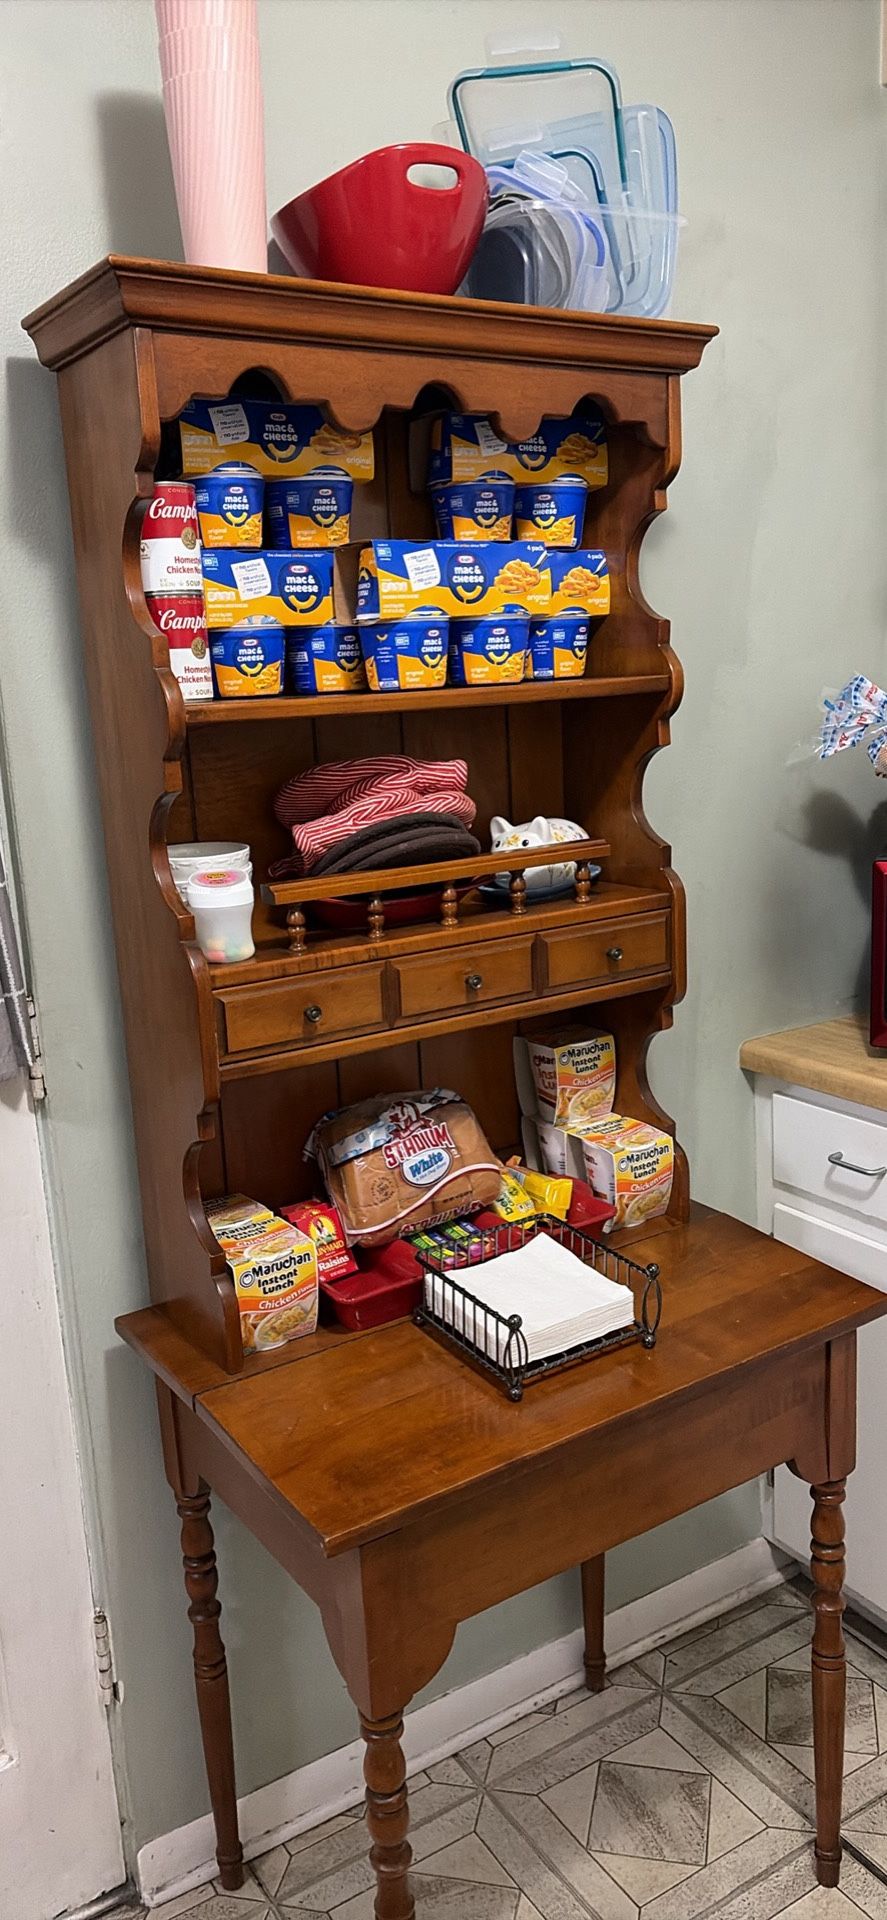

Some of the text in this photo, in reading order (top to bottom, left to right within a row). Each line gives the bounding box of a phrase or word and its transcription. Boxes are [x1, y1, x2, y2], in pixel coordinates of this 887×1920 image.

[568, 1042, 610, 1058] Maruchan
[572, 1054, 601, 1067] Instant
[576, 1063, 598, 1074] Lunch
[383, 1123, 454, 1168] STADIUM
[626, 1144, 669, 1164] Maruchan
[409, 1152, 444, 1178] White
[630, 1158, 660, 1172] Instant
[634, 1168, 656, 1179] Lunch
[252, 1252, 311, 1278] Maruchan
[318, 1255, 350, 1272] Raisins
[258, 1269, 298, 1288] Instant
[263, 1280, 294, 1295] Lunch
[259, 1292, 298, 1310] Chicken
